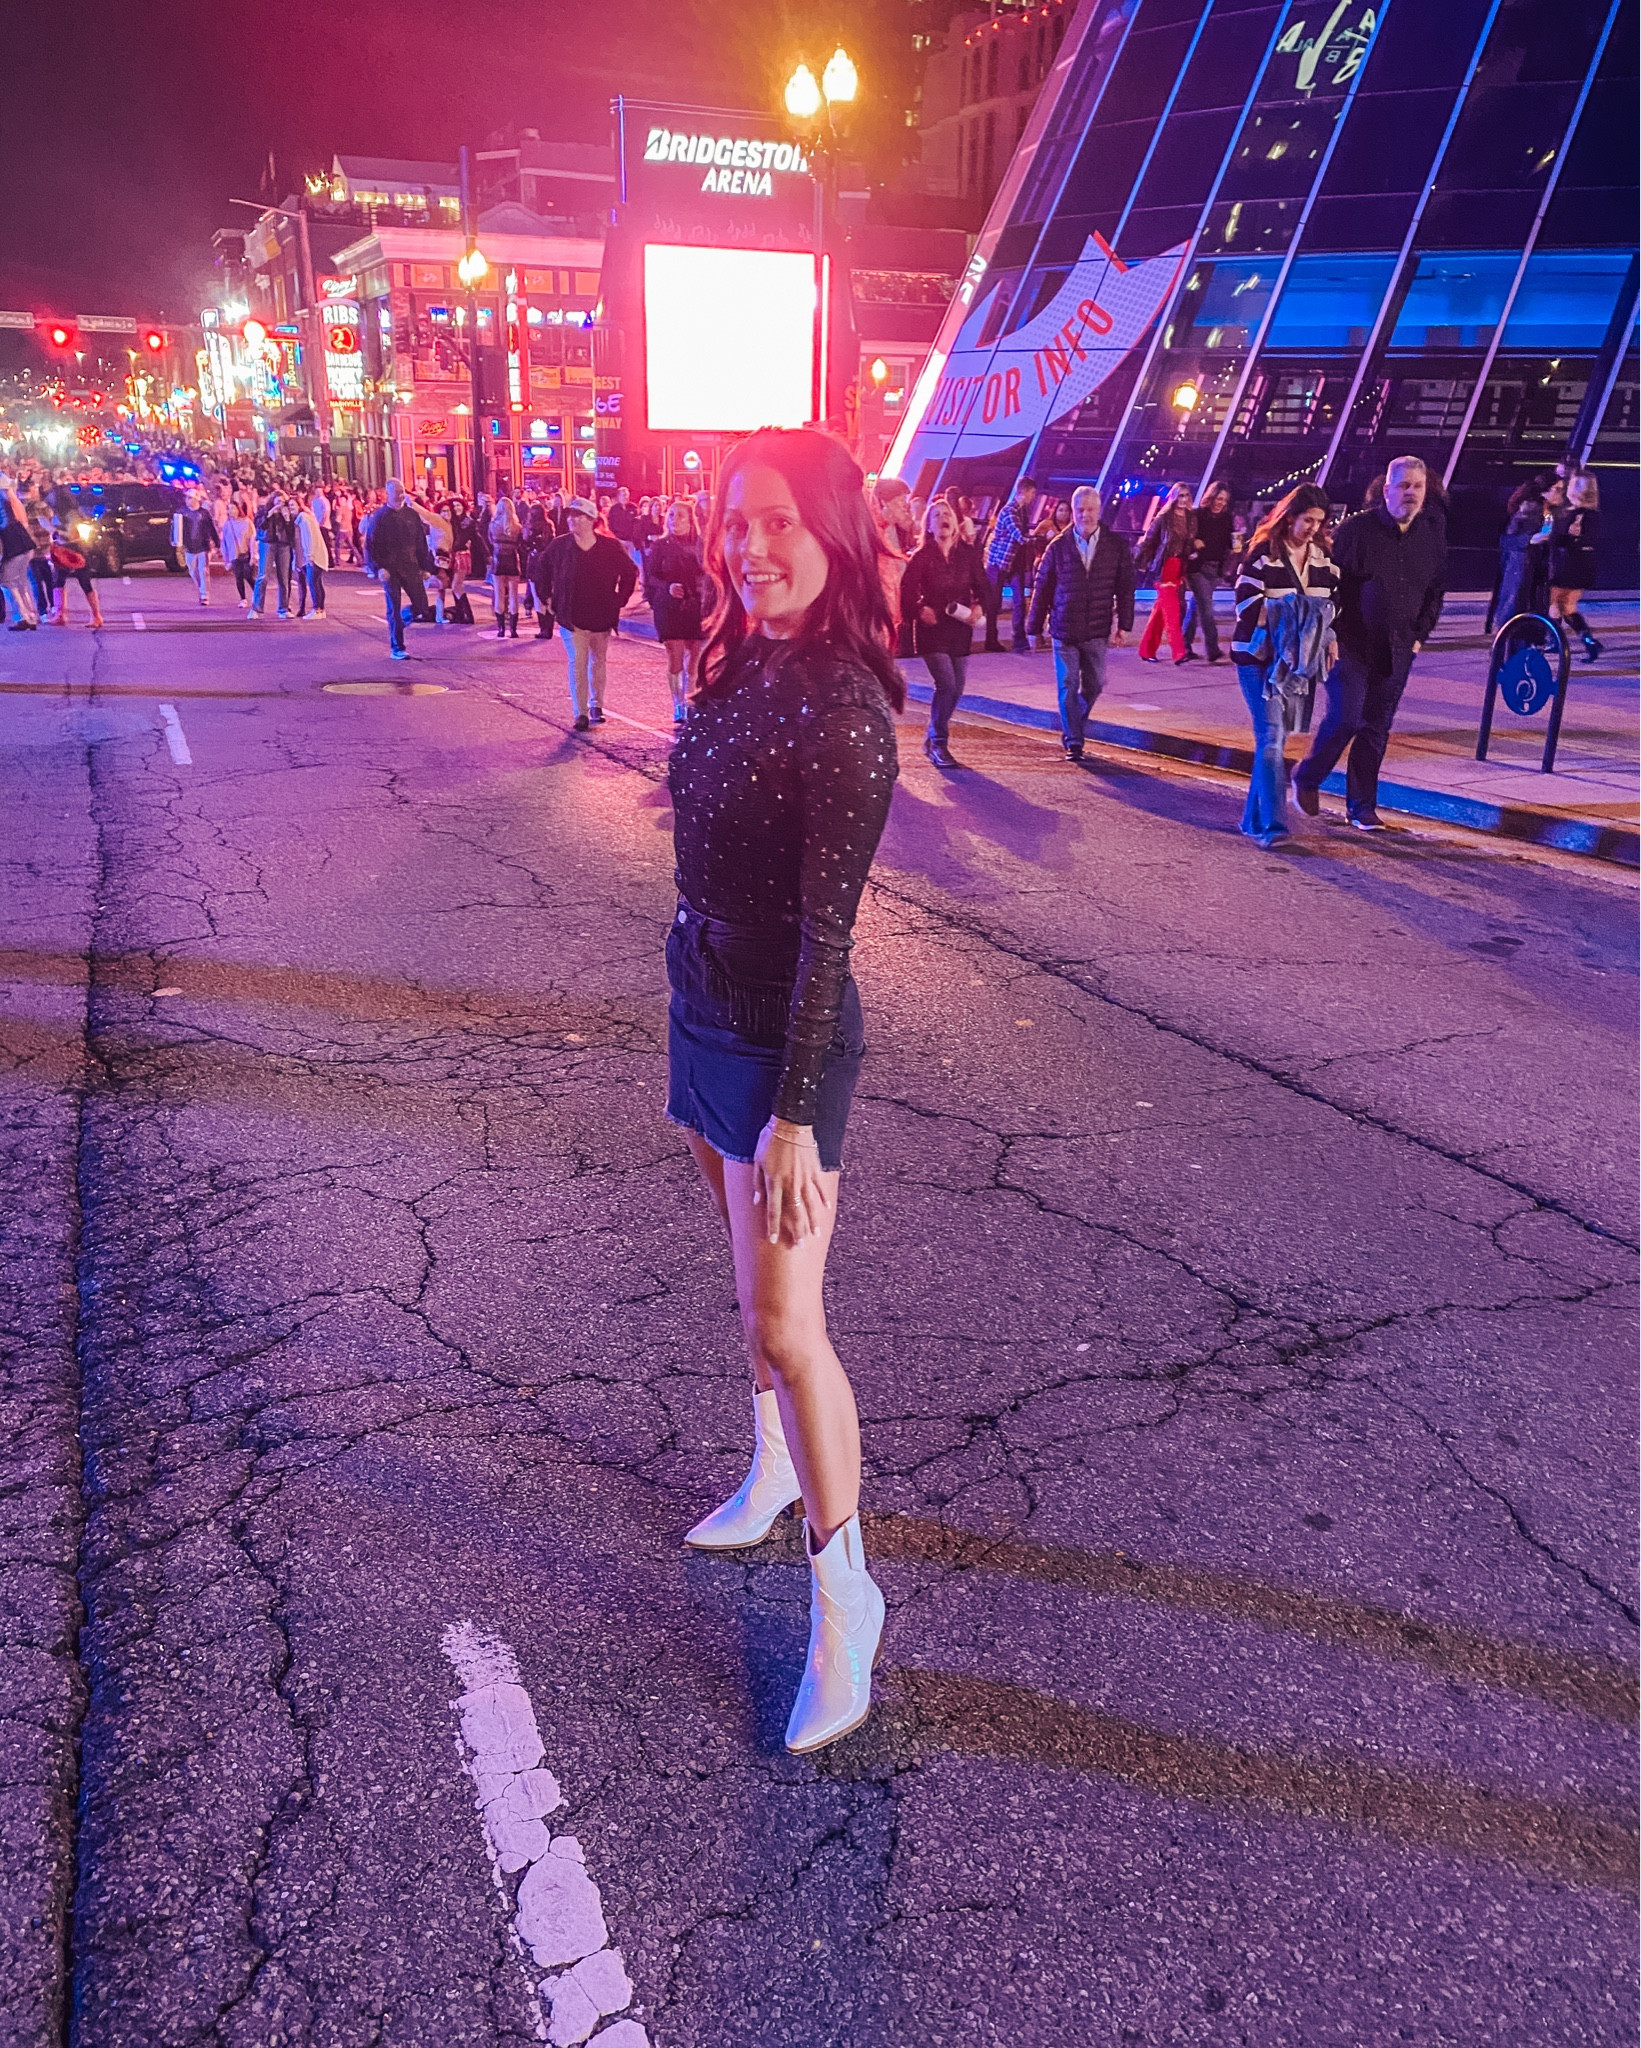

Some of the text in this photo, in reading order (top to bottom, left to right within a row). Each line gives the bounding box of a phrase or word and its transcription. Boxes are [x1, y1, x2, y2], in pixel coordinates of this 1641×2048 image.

[644, 128, 809, 172] BRIDGESTON
[701, 167, 772, 196] ARENA
[322, 305, 359, 325] RIBS
[925, 298, 1113, 426] VISITOR INFO
